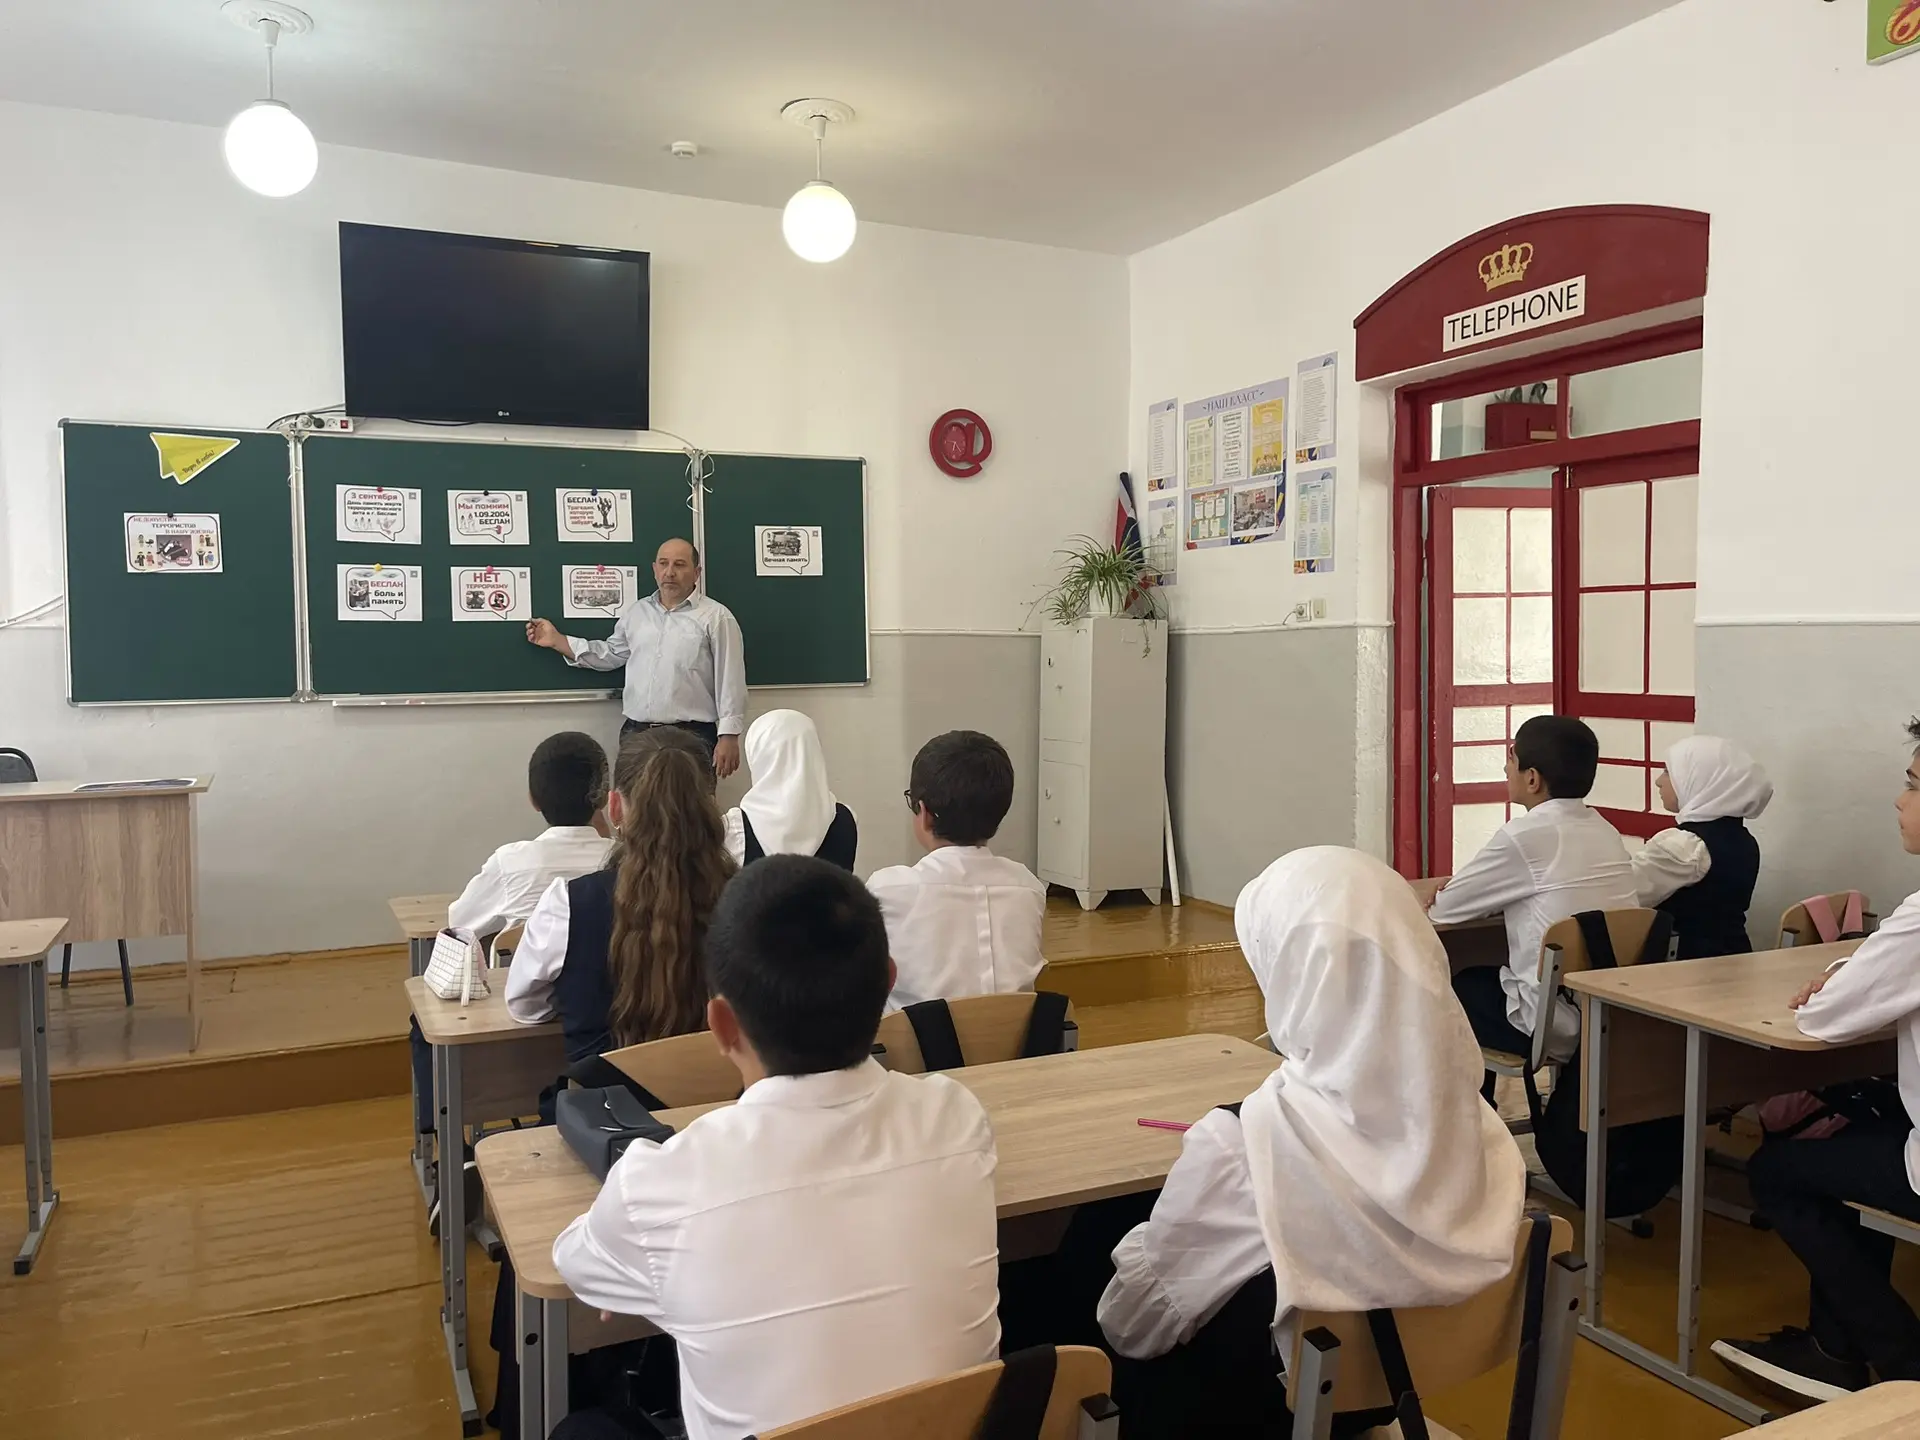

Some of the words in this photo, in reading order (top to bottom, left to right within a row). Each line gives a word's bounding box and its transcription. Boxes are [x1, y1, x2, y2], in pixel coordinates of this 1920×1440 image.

[1447, 282, 1579, 343] TELEPHONE
[358, 493, 398, 501] сентября
[567, 496, 598, 504] БЕСЛАН
[473, 572, 501, 583] НЕТ
[370, 580, 404, 588] БЕСЛАН
[374, 589, 396, 597] боль
